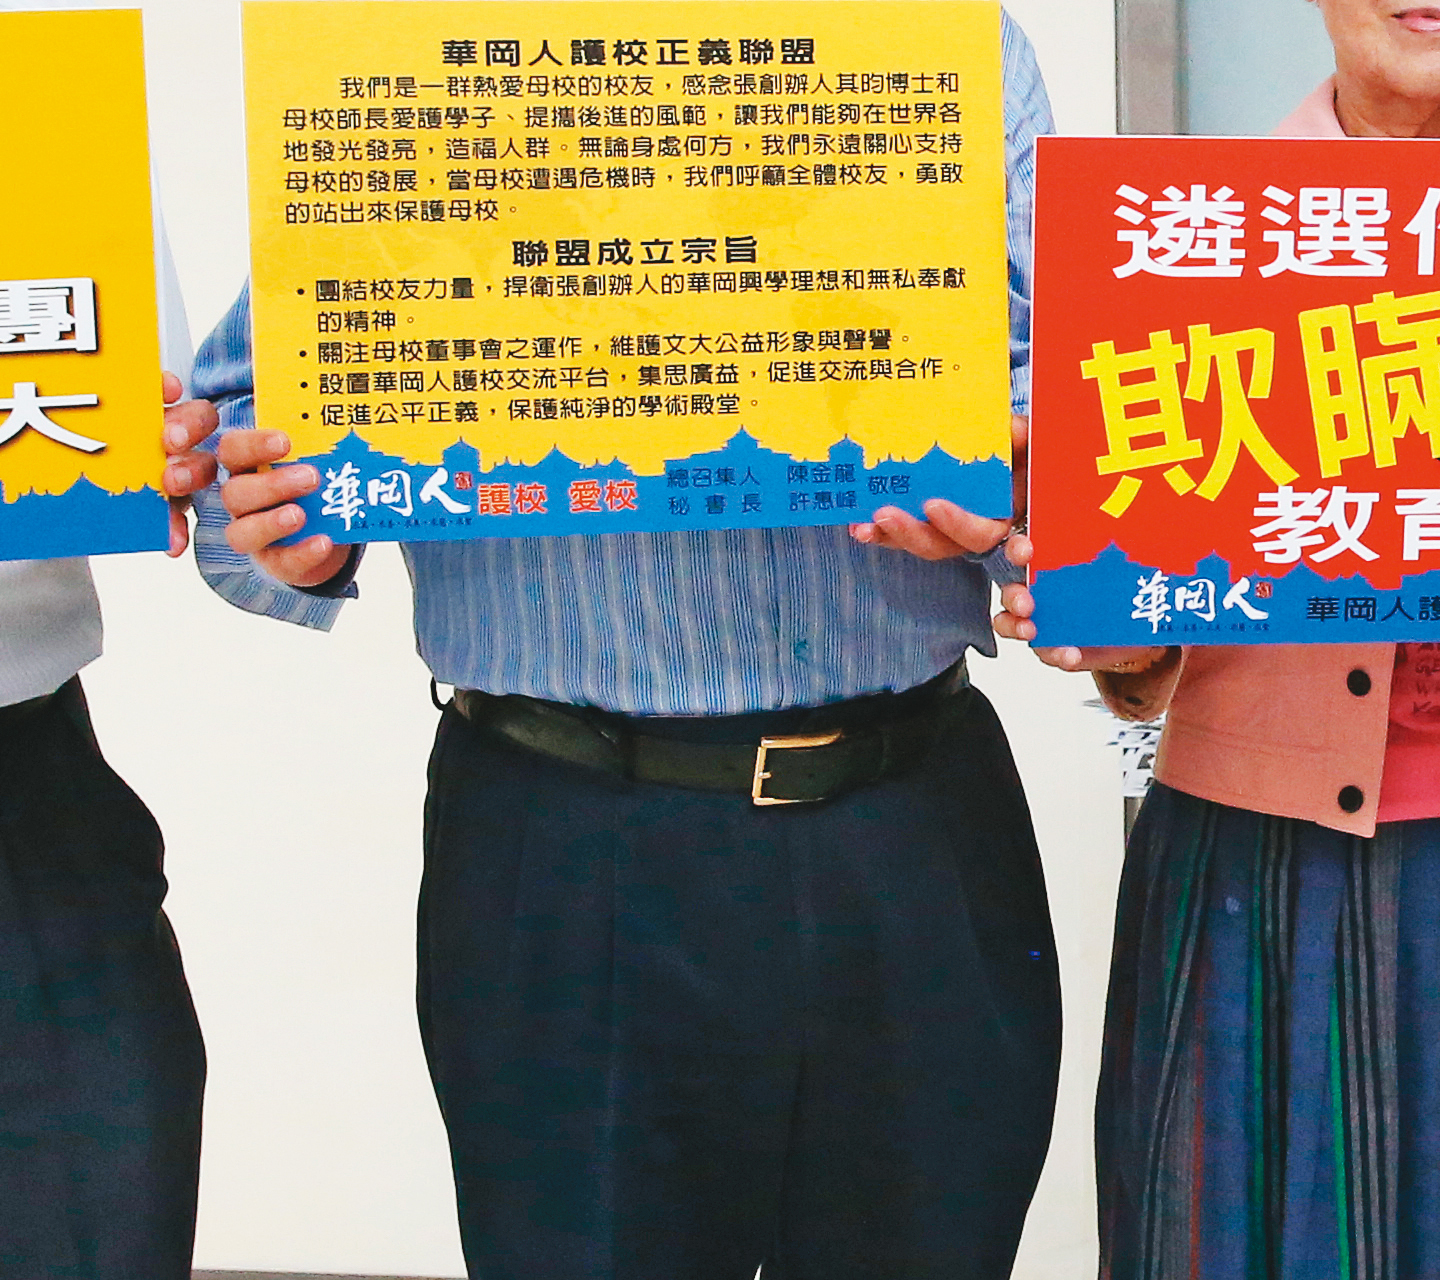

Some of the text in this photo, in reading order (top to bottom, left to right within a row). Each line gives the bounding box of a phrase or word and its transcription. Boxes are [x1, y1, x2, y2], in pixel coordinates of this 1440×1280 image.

[442, 38, 815, 67] 華岡人護校正義聯盟
[286, 199, 517, 224] 的站出來保護母校。
[512, 236, 757, 267] 聯盟成立宗旨
[318, 310, 414, 333] 的精神。
[321, 461, 471, 531] 華岡人
[478, 479, 637, 515] 護校 愛校
[1131, 570, 1269, 634] 華岡人
